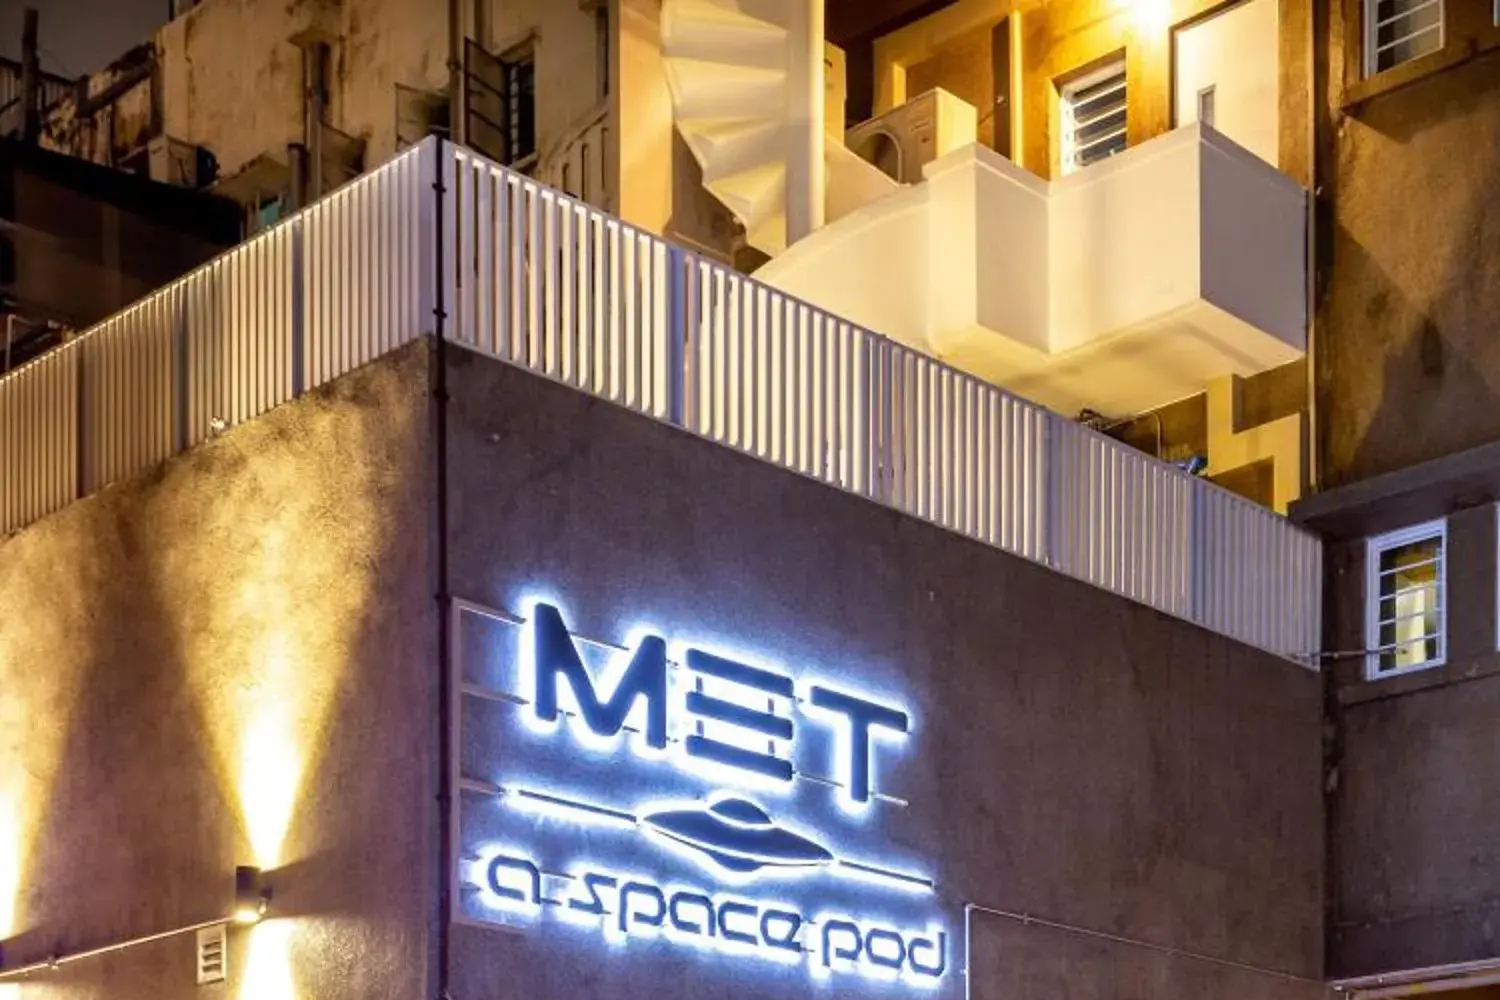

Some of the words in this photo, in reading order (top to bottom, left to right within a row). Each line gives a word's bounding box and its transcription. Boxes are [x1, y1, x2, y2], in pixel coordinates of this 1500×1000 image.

[533, 602, 908, 803] MET
[487, 855, 542, 905] a
[569, 871, 803, 952] space
[822, 918, 946, 978] pod
